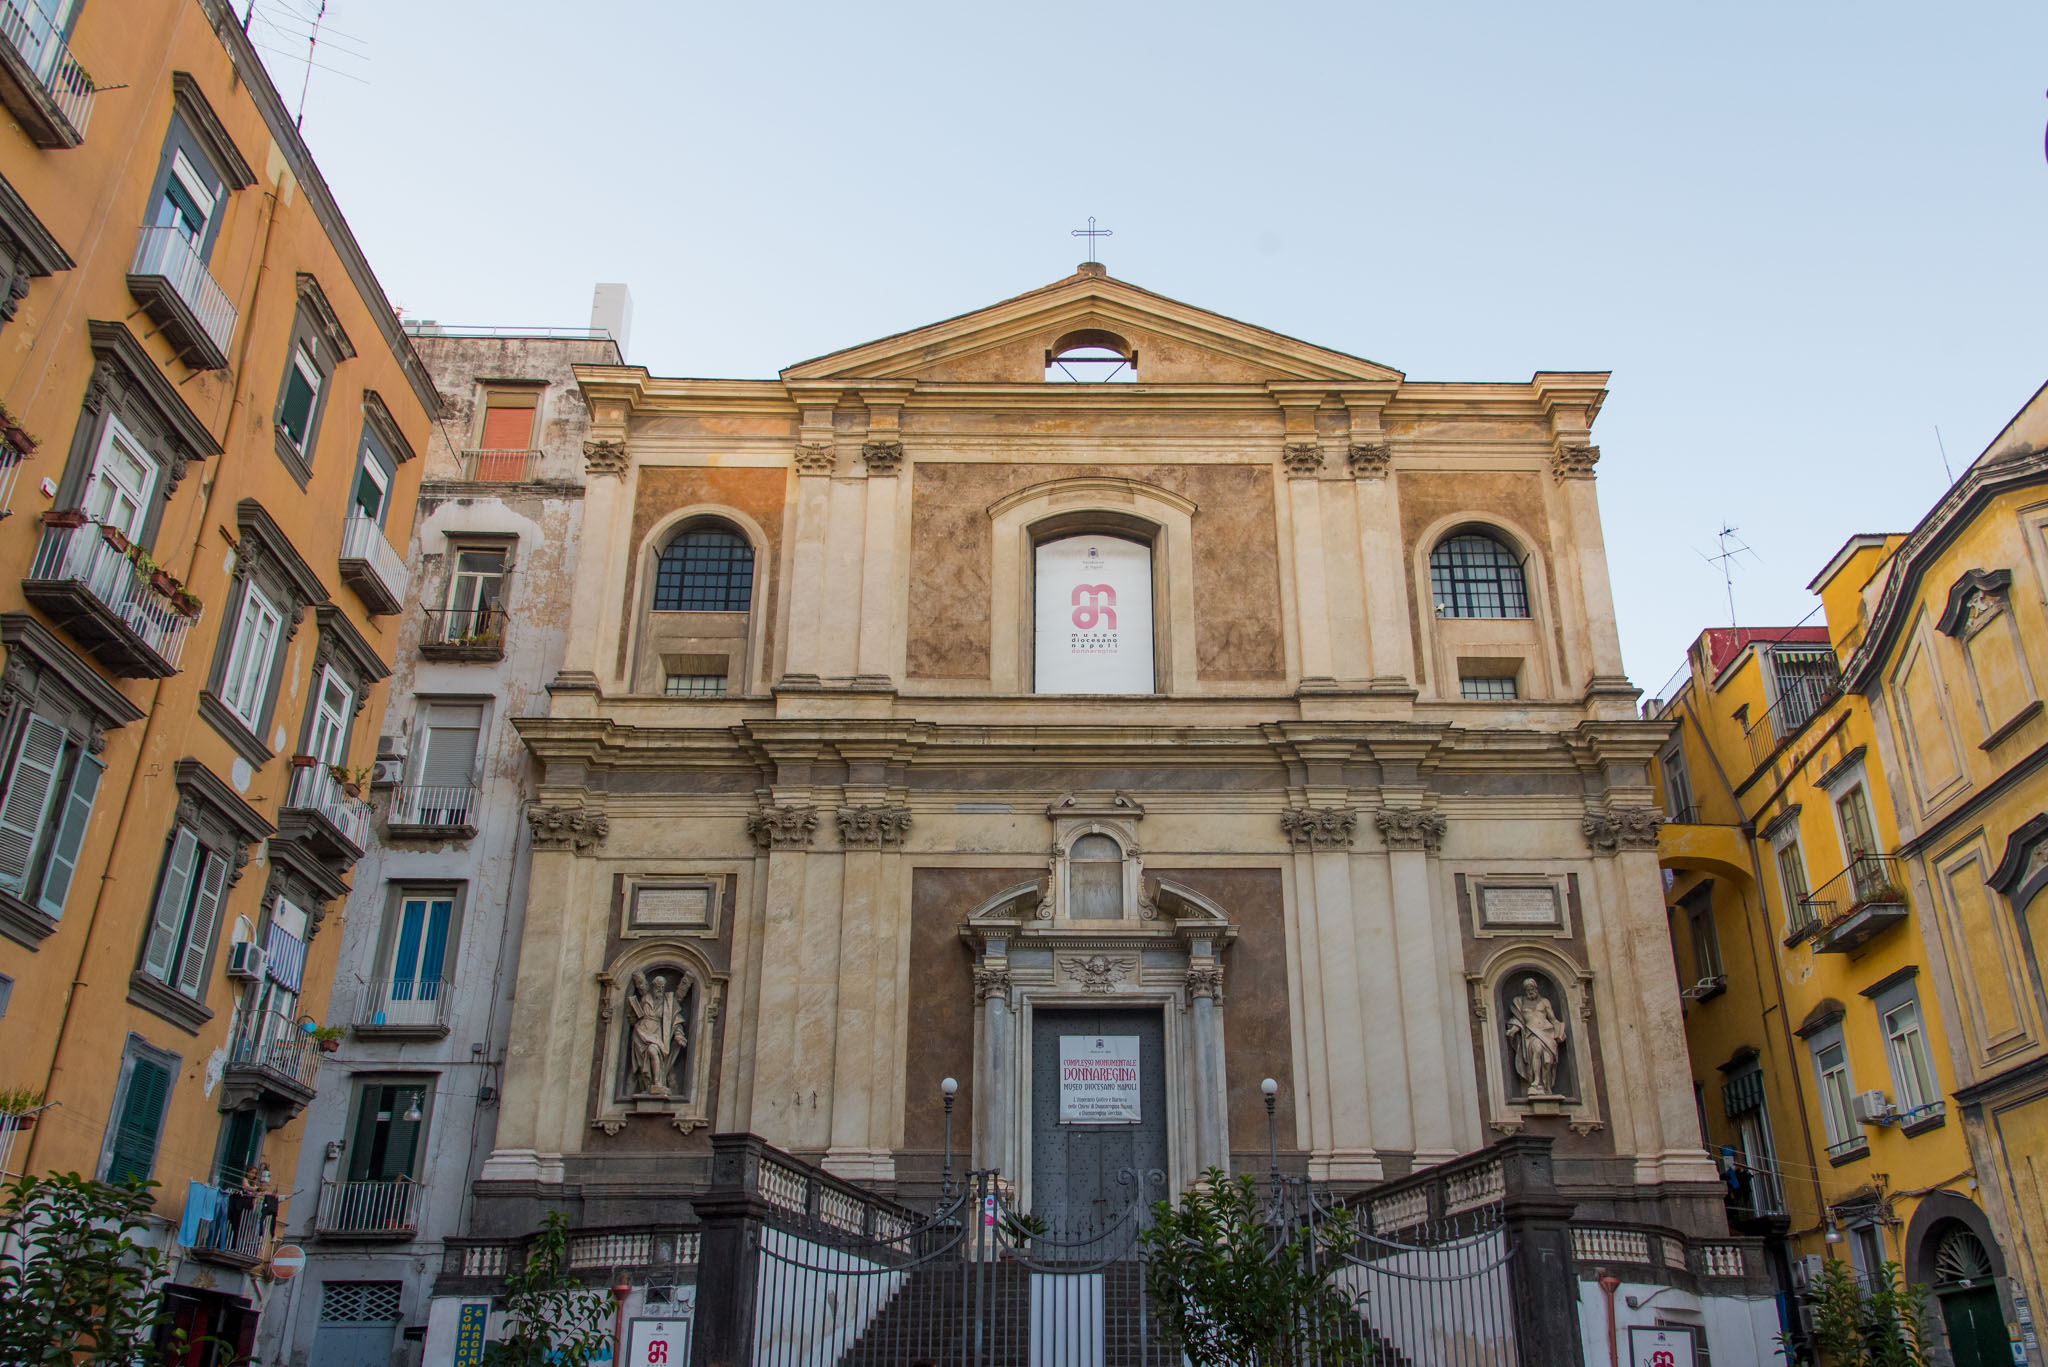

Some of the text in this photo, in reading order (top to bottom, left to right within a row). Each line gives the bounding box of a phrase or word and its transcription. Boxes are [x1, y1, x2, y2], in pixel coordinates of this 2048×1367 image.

[1064, 1059, 1136, 1067] COMPLESSO MONUMENTALE
[1064, 1068, 1136, 1082] DONNAREGINA
[1064, 1083, 1137, 1091] MUSEO DIOCESANO NAPOLI
[459, 1306, 473, 1356] COMPRO
